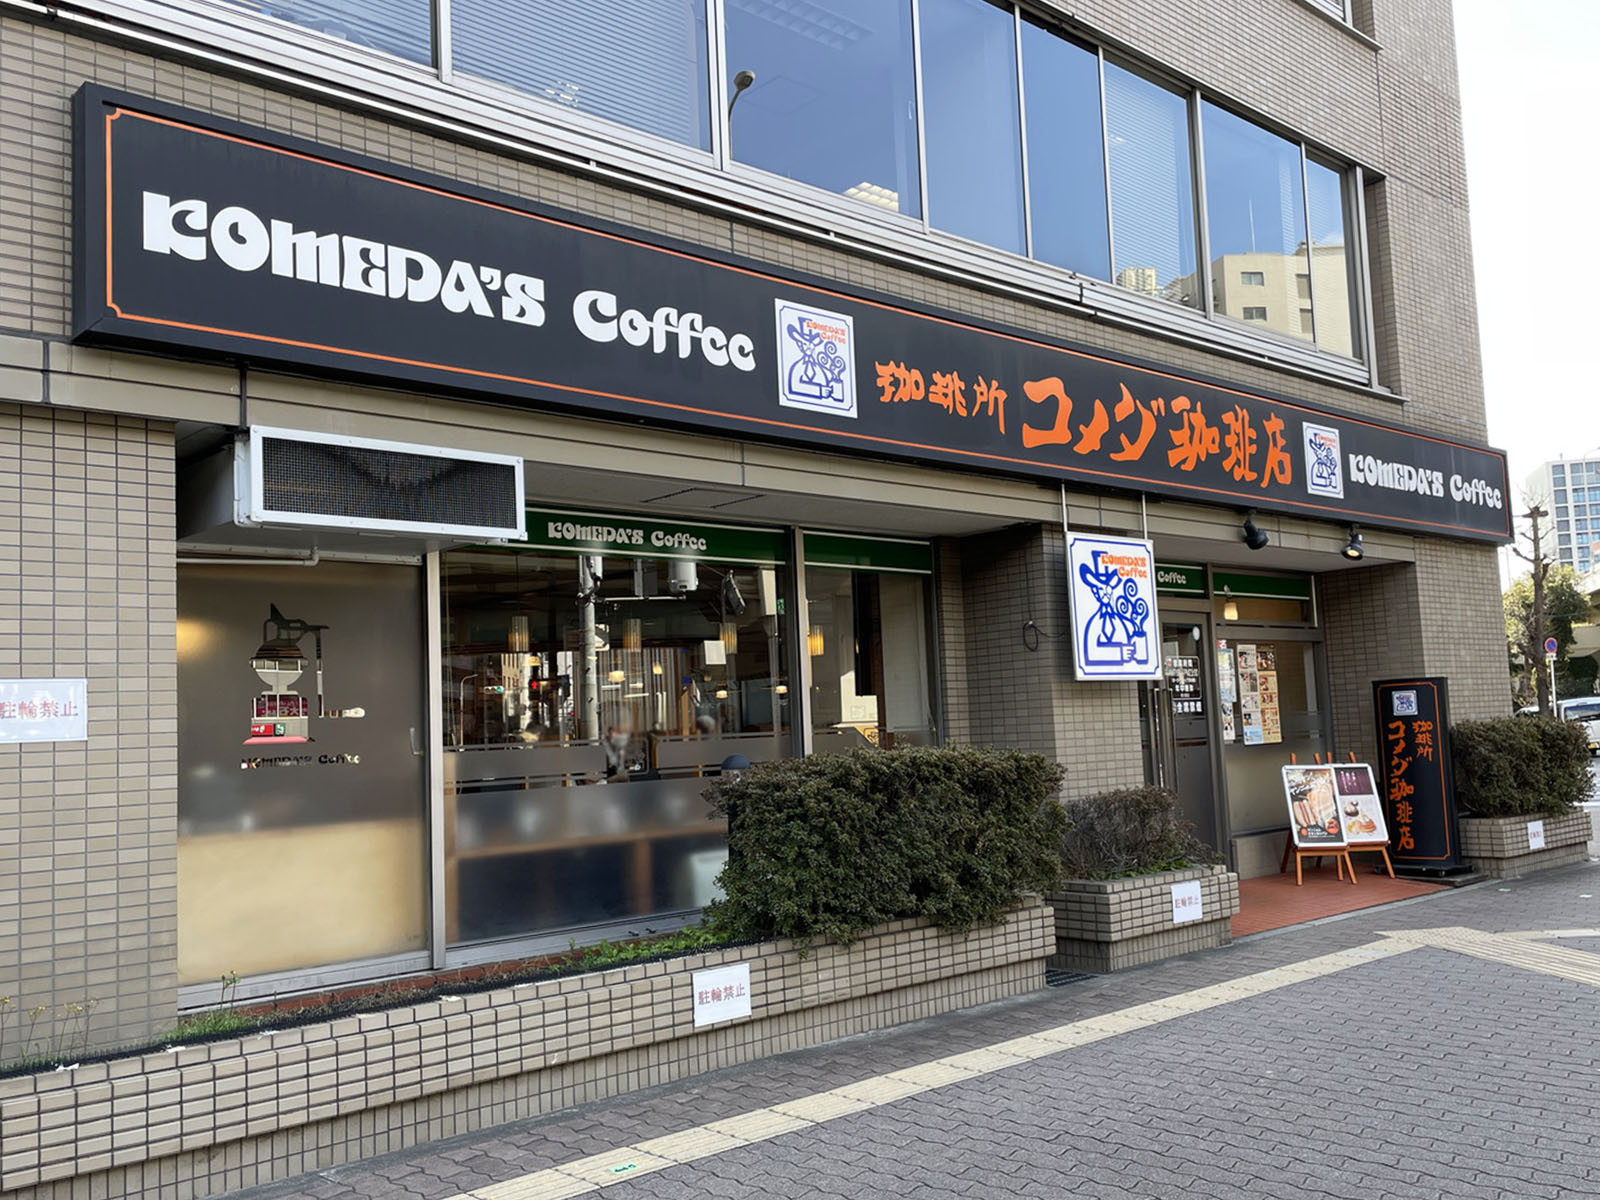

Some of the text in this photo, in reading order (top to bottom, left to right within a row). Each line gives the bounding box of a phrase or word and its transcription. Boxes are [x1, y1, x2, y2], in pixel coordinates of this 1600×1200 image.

[142, 191, 756, 372] KOMEDA'S Coffee
[875, 361, 1008, 435] 珈琲所
[1022, 377, 1293, 488] コメダ珈琲店
[1348, 453, 1503, 510] KOMEDA'S Coffee
[547, 522, 707, 551] KOMEDA'S Coffee
[1101, 554, 1147, 568] KOMEDA'S
[1118, 566, 1148, 579] Coffee
[1157, 571, 1187, 585] Coffee
[1411, 720, 1434, 761] 珈琲所
[1388, 720, 1415, 850] コメダ珈琲店
[698, 983, 746, 1006] 駐輪禁止
